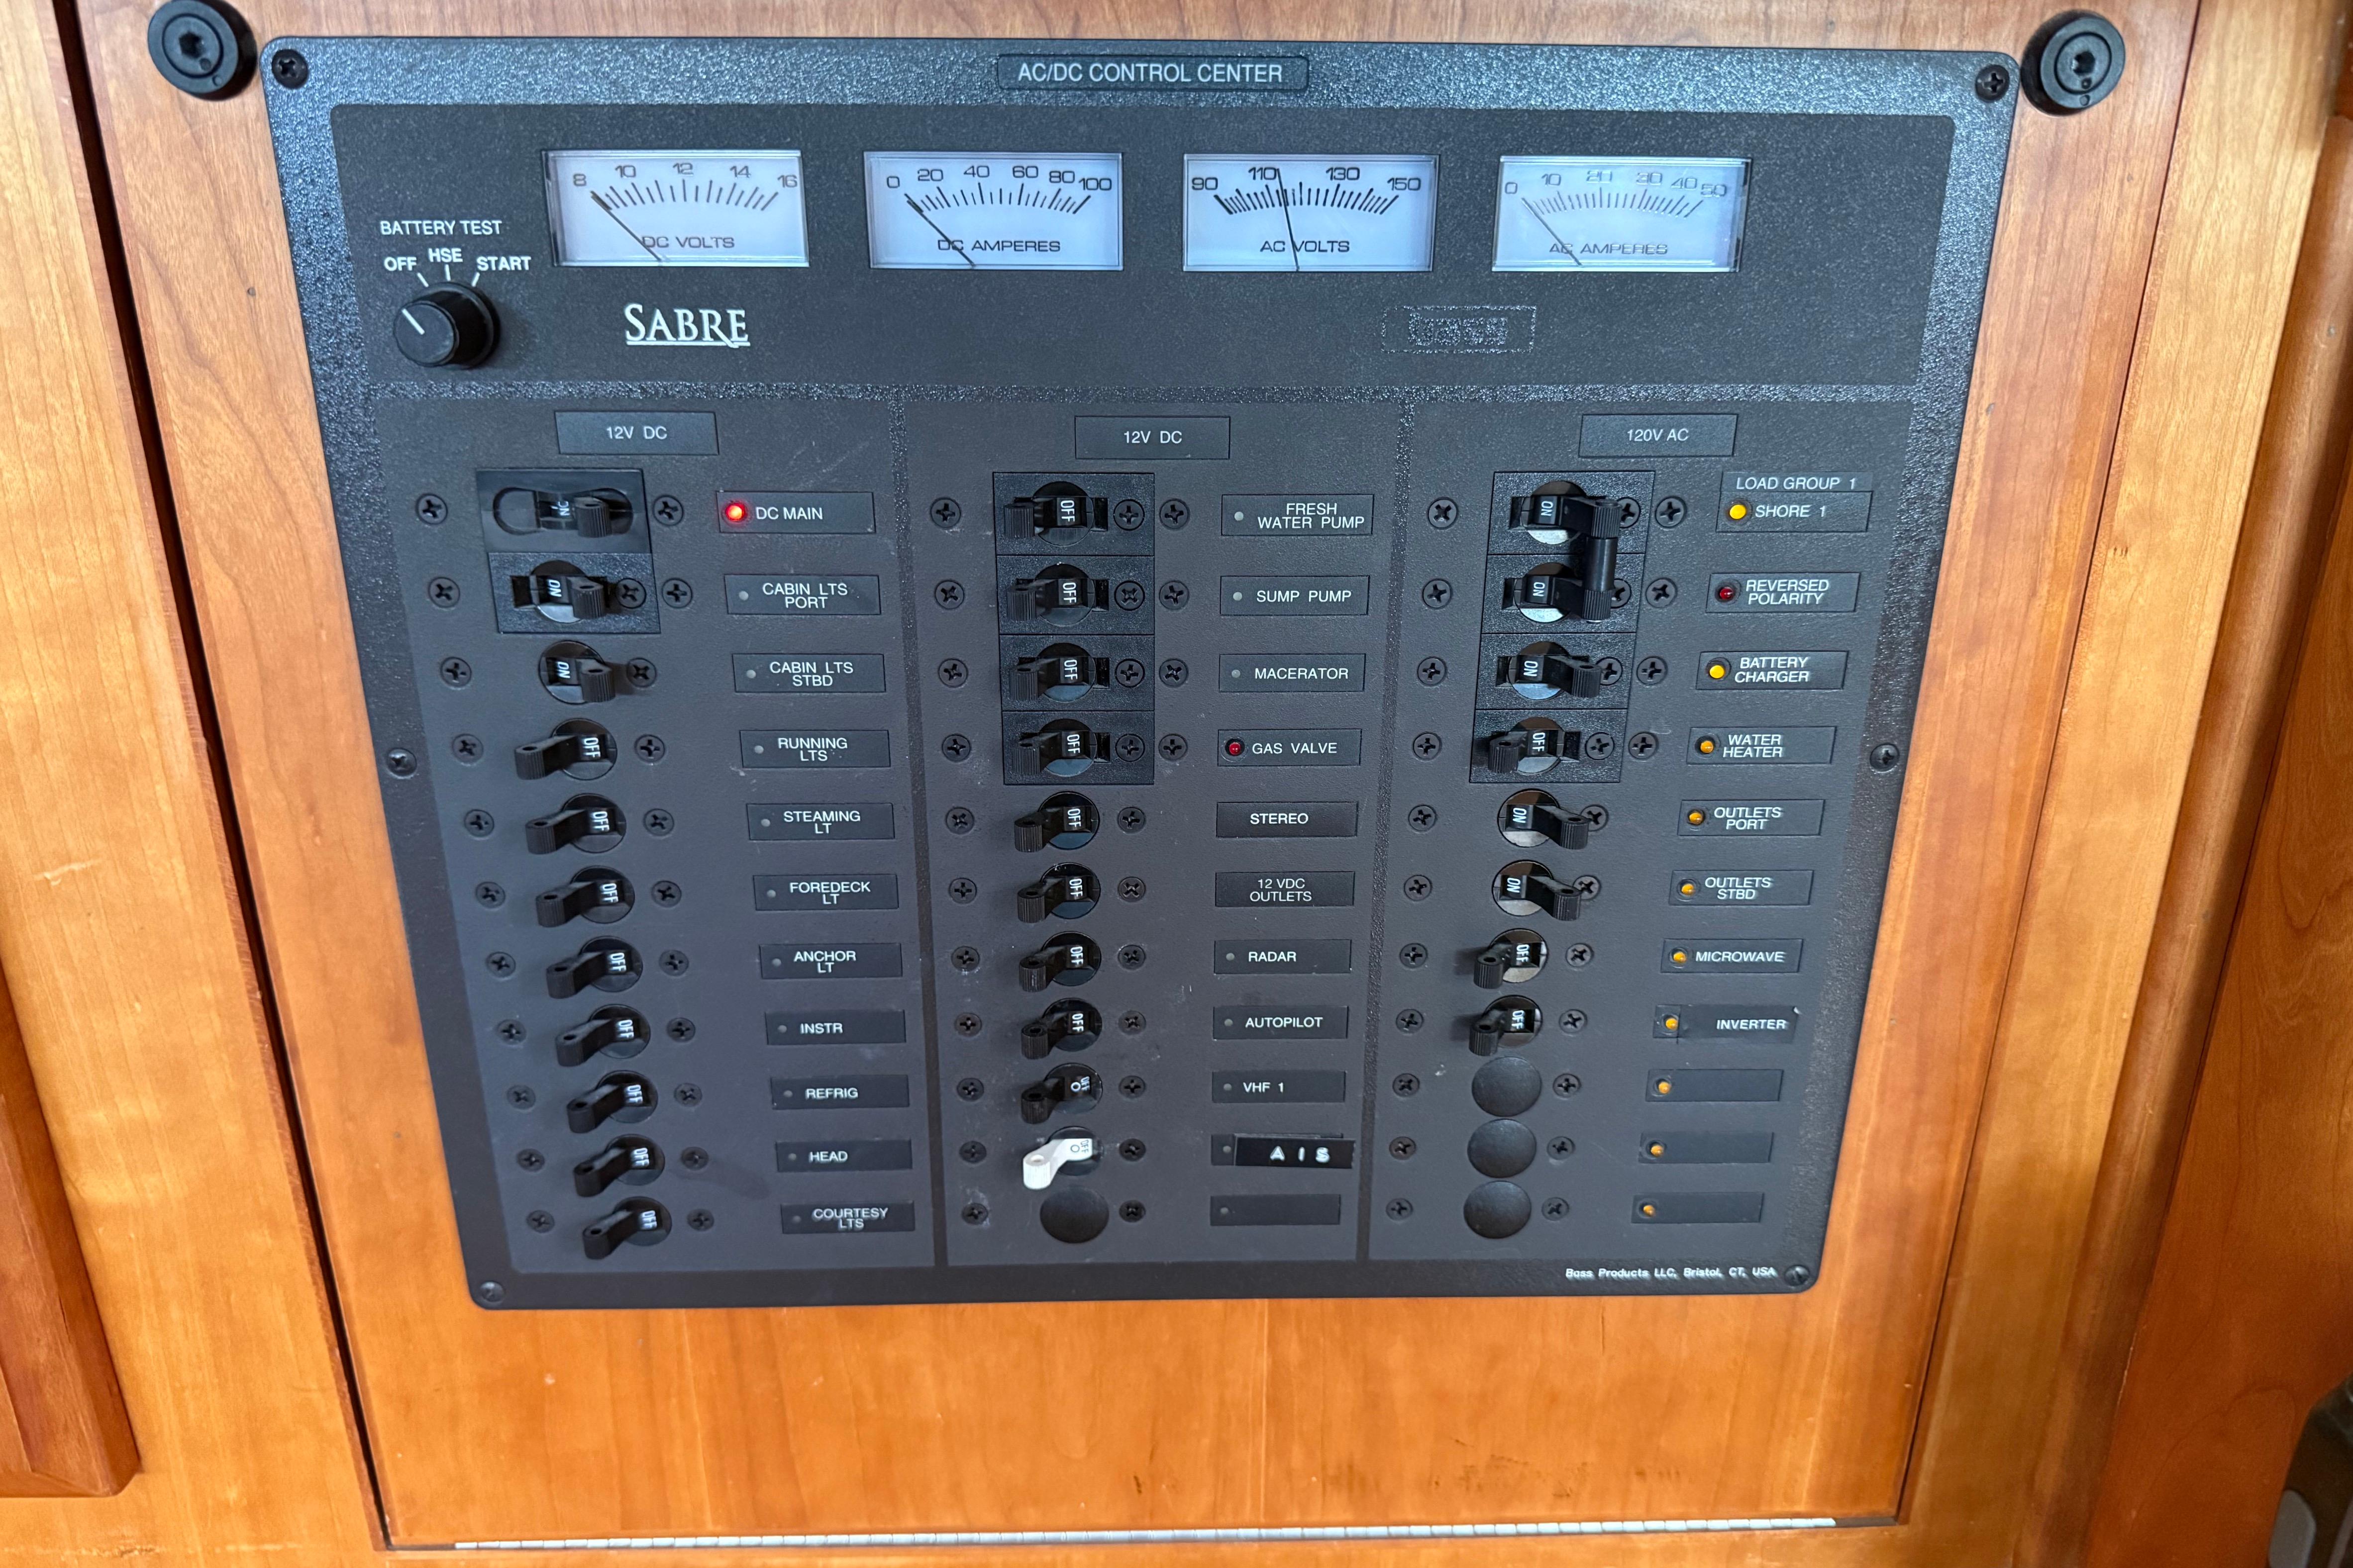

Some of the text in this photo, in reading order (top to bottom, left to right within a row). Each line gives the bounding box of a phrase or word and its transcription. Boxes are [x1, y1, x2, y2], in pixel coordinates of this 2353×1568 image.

[1018, 64, 1282, 83] AC/DC CONTROL CENTER
[573, 163, 797, 188] 8 10 12 14 16
[887, 165, 1112, 191] 0 20 40 60 80 100
[1192, 167, 1421, 191] 90 110 130 150
[1505, 171, 1727, 196] 0 10 20 30 40 50
[381, 220, 502, 235] BATTERY TEST
[642, 236, 735, 248] DC VOLTS
[937, 239, 1060, 252] DC AMPERES
[1260, 241, 1349, 253] AC VOLTS
[428, 248, 462, 262] HSE
[1549, 244, 1668, 254] AC AMPERES
[385, 258, 417, 272] OFF
[477, 257, 531, 271] START
[624, 303, 750, 348] SABRE
[607, 427, 667, 440] 12V DC
[1124, 431, 1182, 443] 12V DC
[1627, 429, 1689, 441] 120V AC
[1737, 478, 1856, 490] LOAD GROUP 1
[756, 507, 822, 520] DC MAIN
[1060, 500, 1075, 522] OFF
[1286, 503, 1337, 515] FRESH
[1540, 501, 1553, 516] ON
[1755, 505, 1827, 518] SHORE 1
[1257, 517, 1365, 529] WATER PUMP
[547, 579, 561, 596] ON
[763, 584, 848, 595] CABIN LTS
[1534, 582, 1545, 597] ON
[1745, 580, 1829, 592] REVERSED
[1063, 582, 1077, 604] OFF
[1257, 590, 1352, 602] SUMP PUMP
[1748, 593, 1824, 604] POLARITY
[785, 596, 827, 608] PORT
[770, 662, 853, 674] CABIN LTS
[1524, 660, 1539, 677] ON
[1740, 657, 1808, 669] BATTERY
[557, 661, 571, 679] ON
[1064, 659, 1077, 681] OFF
[1255, 668, 1348, 679] MACERATOR
[1735, 670, 1809, 682] CHARGER
[793, 675, 833, 686] STBD
[778, 738, 848, 750] RUNNING
[1066, 734, 1080, 754] OFF
[1532, 732, 1545, 752] OFF
[1728, 734, 1781, 745] WATER
[583, 737, 601, 759] OFF
[1252, 743, 1337, 754] GAS VALVE
[1723, 746, 1783, 758] HEATER
[800, 750, 828, 761] LTS
[784, 811, 861, 822] STEAMING
[1067, 808, 1081, 828] OFF
[1250, 813, 1309, 825] STEREO
[1512, 807, 1527, 824] ON
[1714, 807, 1782, 819] OUTLETS
[592, 811, 610, 833] OFF
[1726, 819, 1769, 830] PORT
[815, 823, 832, 834] LT
[790, 882, 870, 892] FOREDECK
[1069, 878, 1082, 898] OFF
[1257, 879, 1306, 889] 12 VDC
[1506, 877, 1520, 893] ON
[1705, 877, 1773, 888] OUTLETS
[602, 883, 618, 904] OFF
[823, 893, 839, 904] LT
[1250, 890, 1312, 901] OUTLETS
[1717, 888, 1758, 900] STBD
[794, 950, 856, 962] ANCHOR
[1070, 946, 1083, 967] OFF
[1248, 951, 1296, 962] RADAR
[1516, 944, 1530, 963] OFF
[1696, 951, 1786, 963] MICROWAVE
[610, 952, 626, 974] OFF
[818, 962, 835, 973] LT
[1072, 1013, 1084, 1033] OFF
[1245, 1017, 1323, 1028] AUTOPILOT
[1513, 1010, 1525, 1030] OFF
[1716, 1019, 1787, 1030] INVERTER
[617, 1020, 634, 1040] OFF
[800, 1023, 843, 1034] INSTR
[1243, 1081, 1284, 1092] VHF 1
[626, 1084, 642, 1104] OFF
[805, 1087, 858, 1099] REFRIG
[1080, 1139, 1090, 1155] OFF
[632, 1148, 649, 1167] OFF
[809, 1151, 848, 1162] HEAD
[640, 1210, 657, 1230] OFF
[812, 1208, 889, 1220] COURTESY
[838, 1218, 864, 1231] LTS
[1598, 1268, 1649, 1280] Products
[1752, 1267, 1777, 1278] USA
